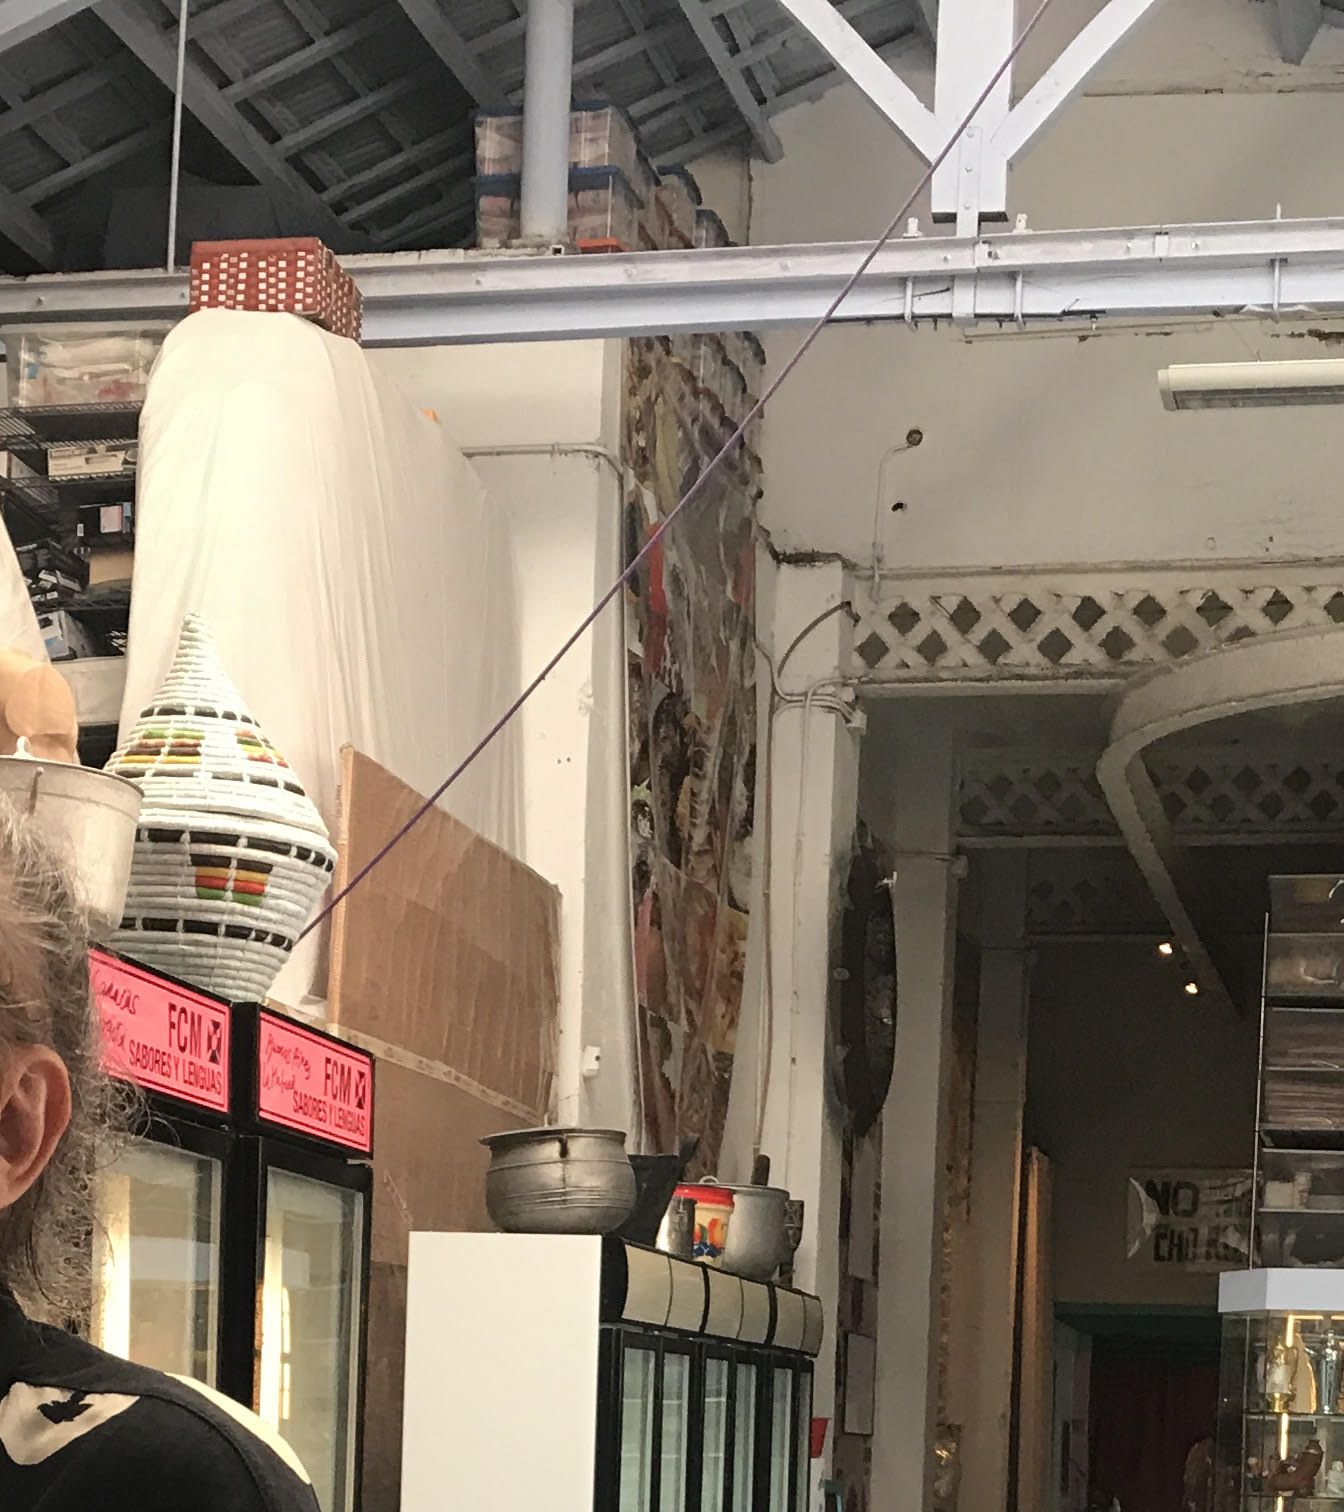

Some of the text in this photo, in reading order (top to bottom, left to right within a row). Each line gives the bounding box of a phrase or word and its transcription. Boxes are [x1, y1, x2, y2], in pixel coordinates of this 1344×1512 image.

[168, 1002, 202, 1058] FCM
[129, 1039, 172, 1079] SABORES
[173, 1059, 180, 1081] Y
[183, 1060, 222, 1095] LENGUAS
[323, 1057, 352, 1106] FCM
[293, 1090, 365, 1136] SABORES Y LENGUAS
